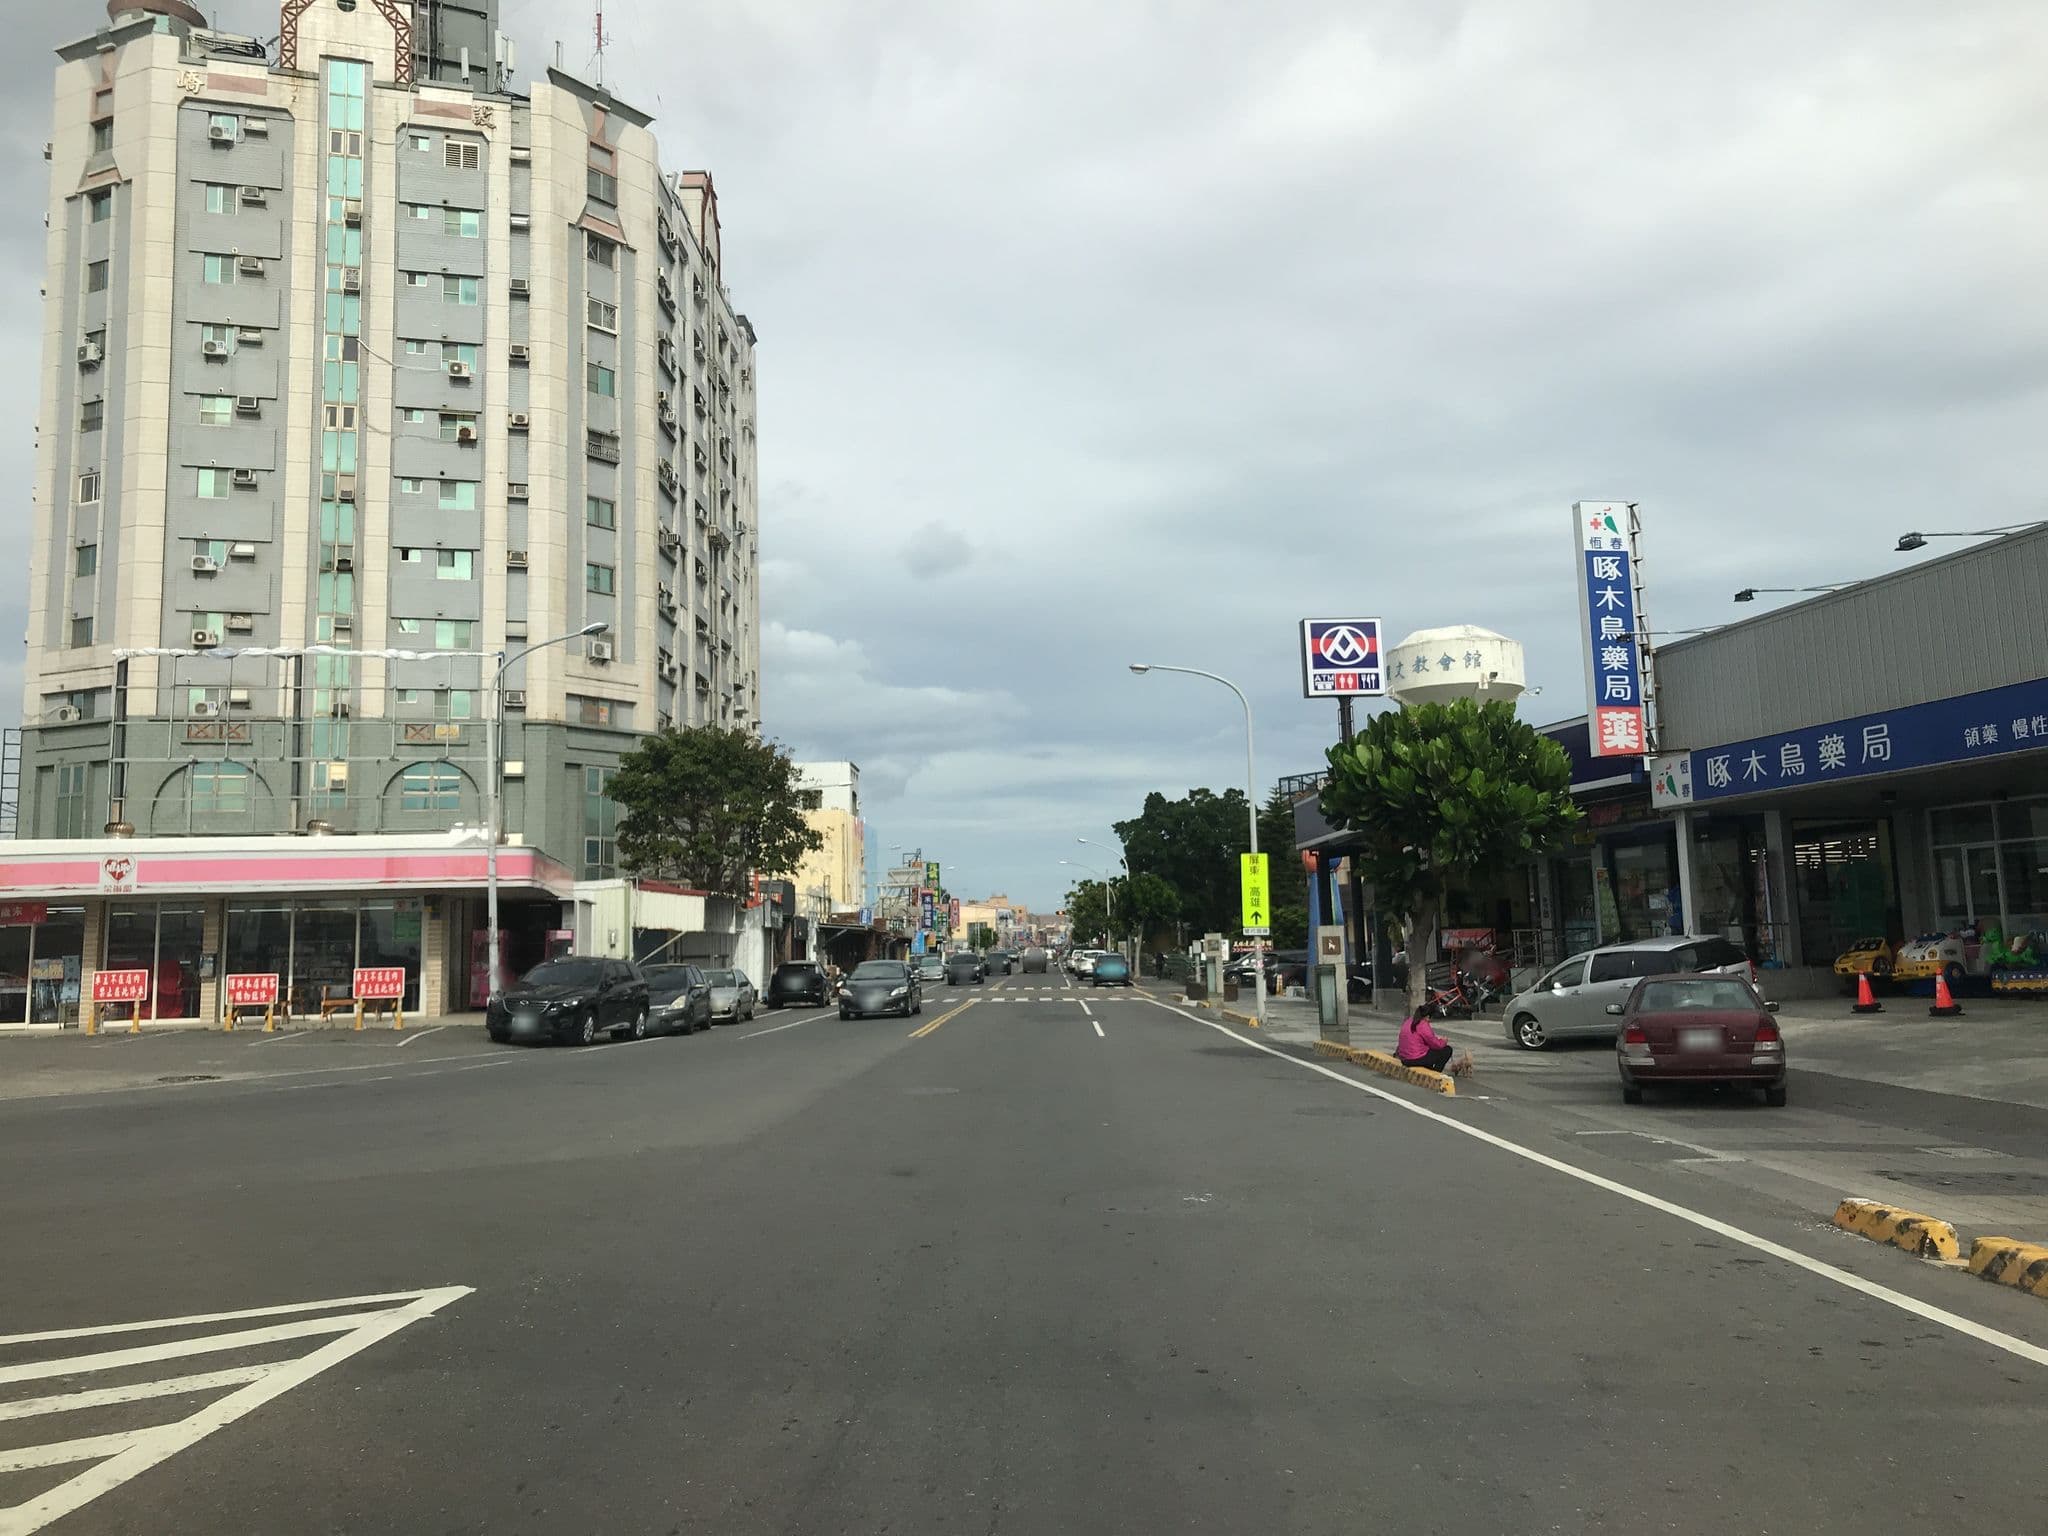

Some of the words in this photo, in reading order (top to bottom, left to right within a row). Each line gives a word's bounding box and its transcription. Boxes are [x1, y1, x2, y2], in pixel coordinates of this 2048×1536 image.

[1593, 556, 1632, 702] 啄木鳥藥局
[1314, 674, 1334, 682] ATM
[1706, 723, 1892, 789] 啄木鳥藥局
[1964, 723, 1999, 748] 領藥
